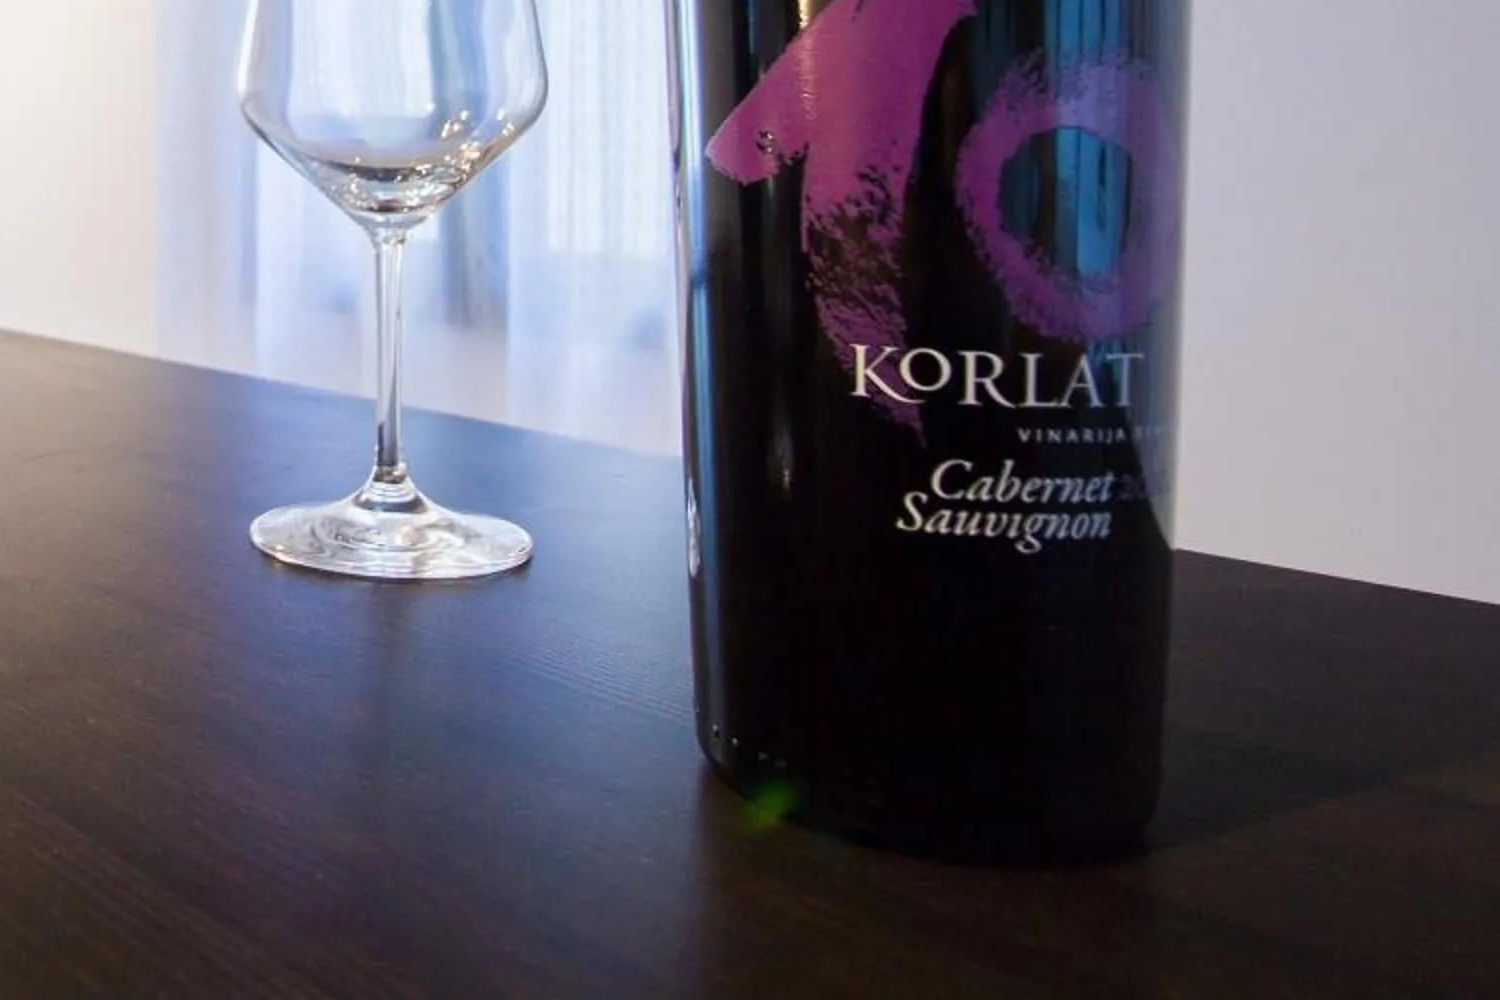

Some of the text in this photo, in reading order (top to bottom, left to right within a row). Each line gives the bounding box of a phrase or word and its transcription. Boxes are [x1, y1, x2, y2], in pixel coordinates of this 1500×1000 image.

[849, 342, 1145, 410] KORLAT
[1017, 426, 1127, 445] VINARIJA
[930, 457, 1116, 504] Cabernet
[896, 490, 1112, 555] Sauvignon
